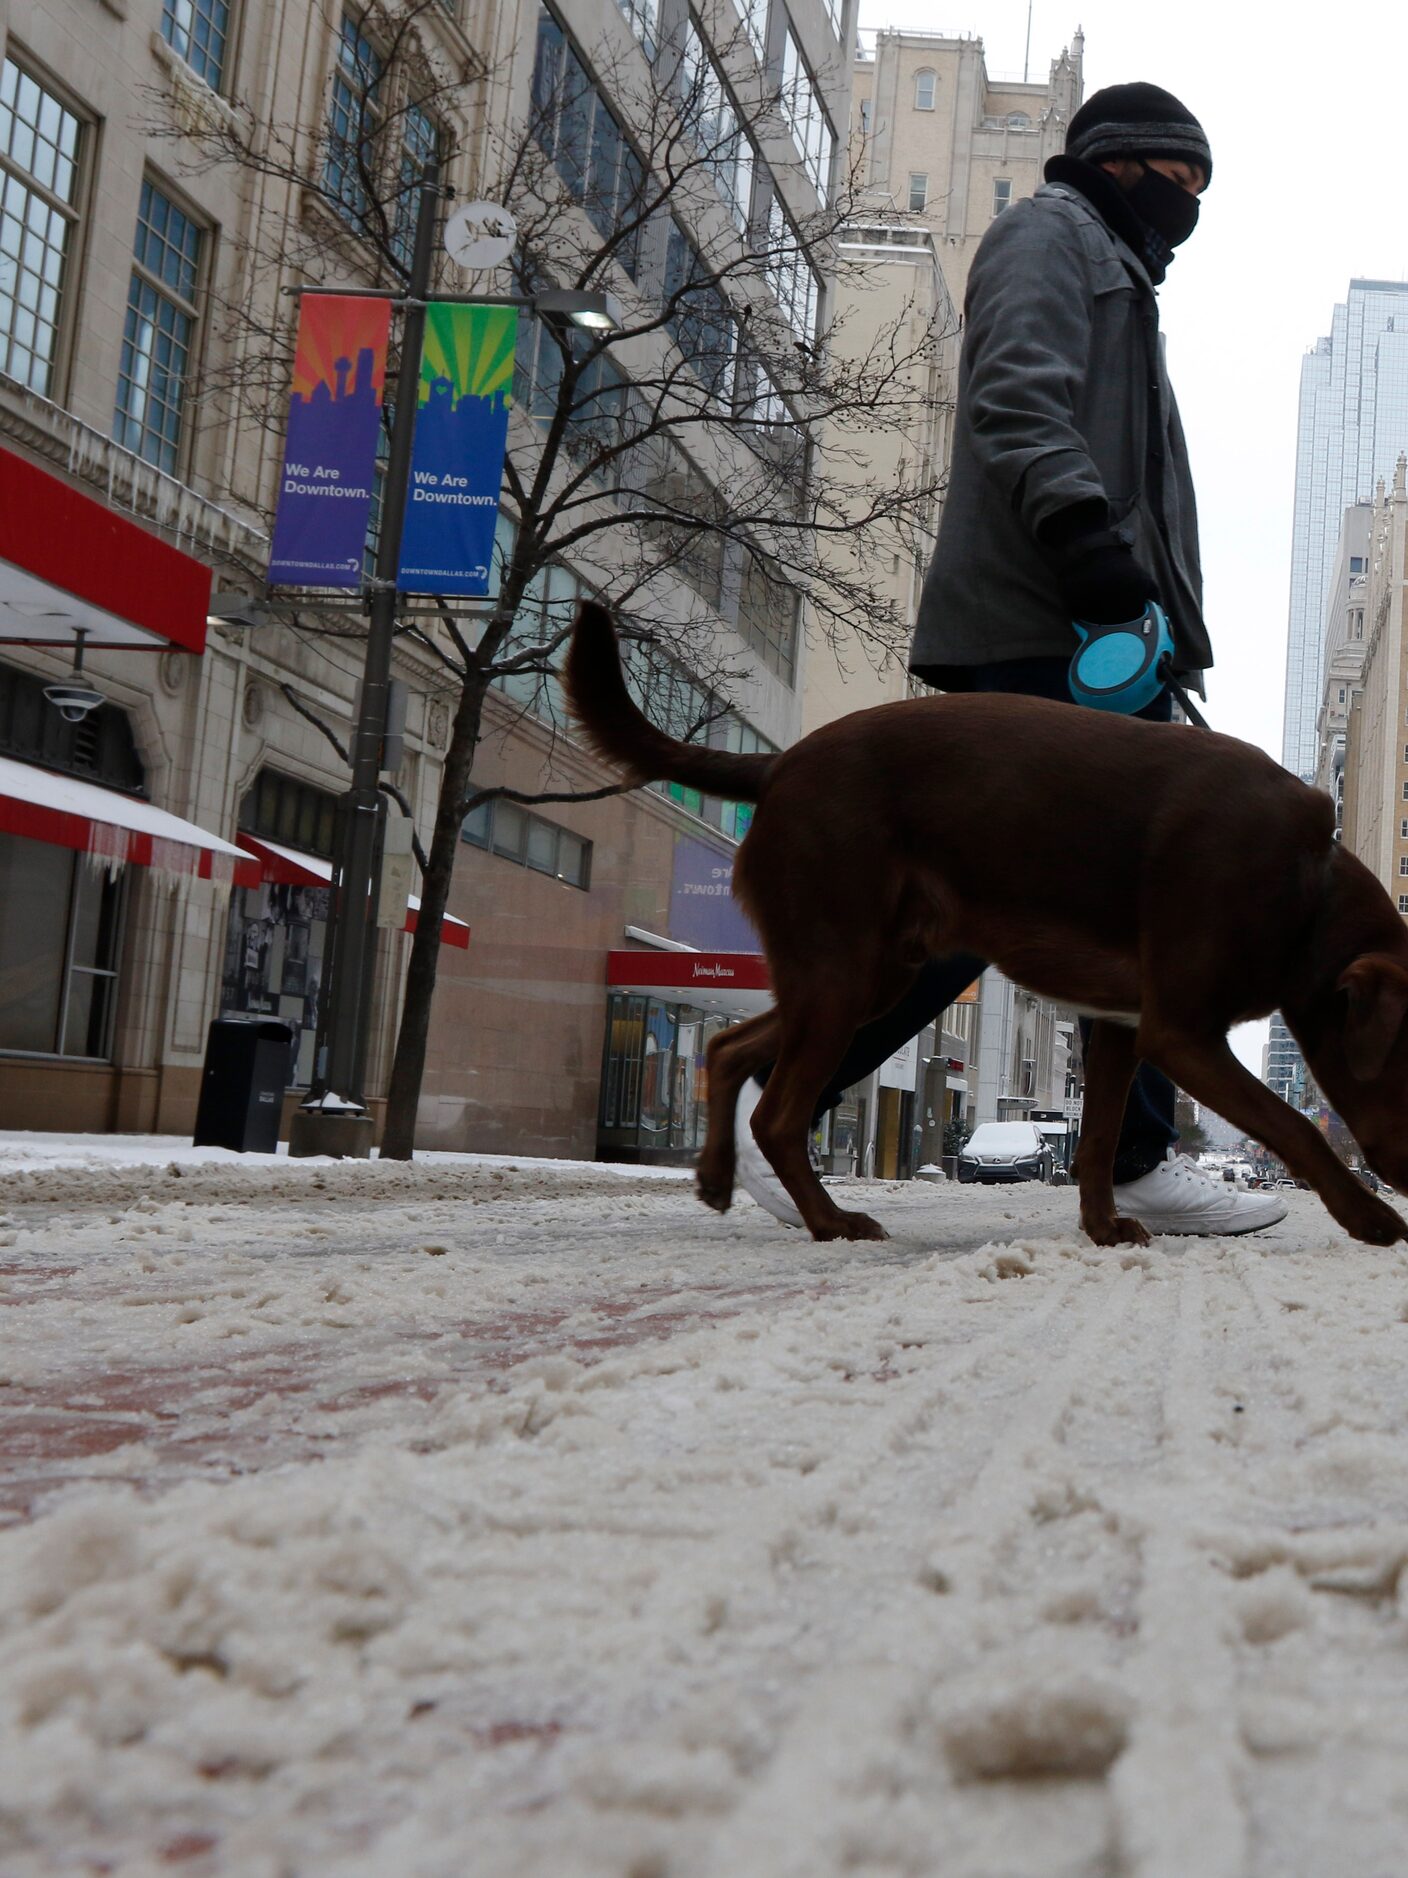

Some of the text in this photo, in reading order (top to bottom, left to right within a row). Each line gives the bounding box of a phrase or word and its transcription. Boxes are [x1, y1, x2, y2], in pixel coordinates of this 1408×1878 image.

[285, 463, 340, 479] We Are
[413, 471, 468, 488] We Are
[284, 480, 370, 499] Downtown.
[413, 489, 498, 507] Downtown.
[400, 567, 479, 577] DOWNTOWNDALLAS.COM
[692, 961, 714, 978] Neiman
